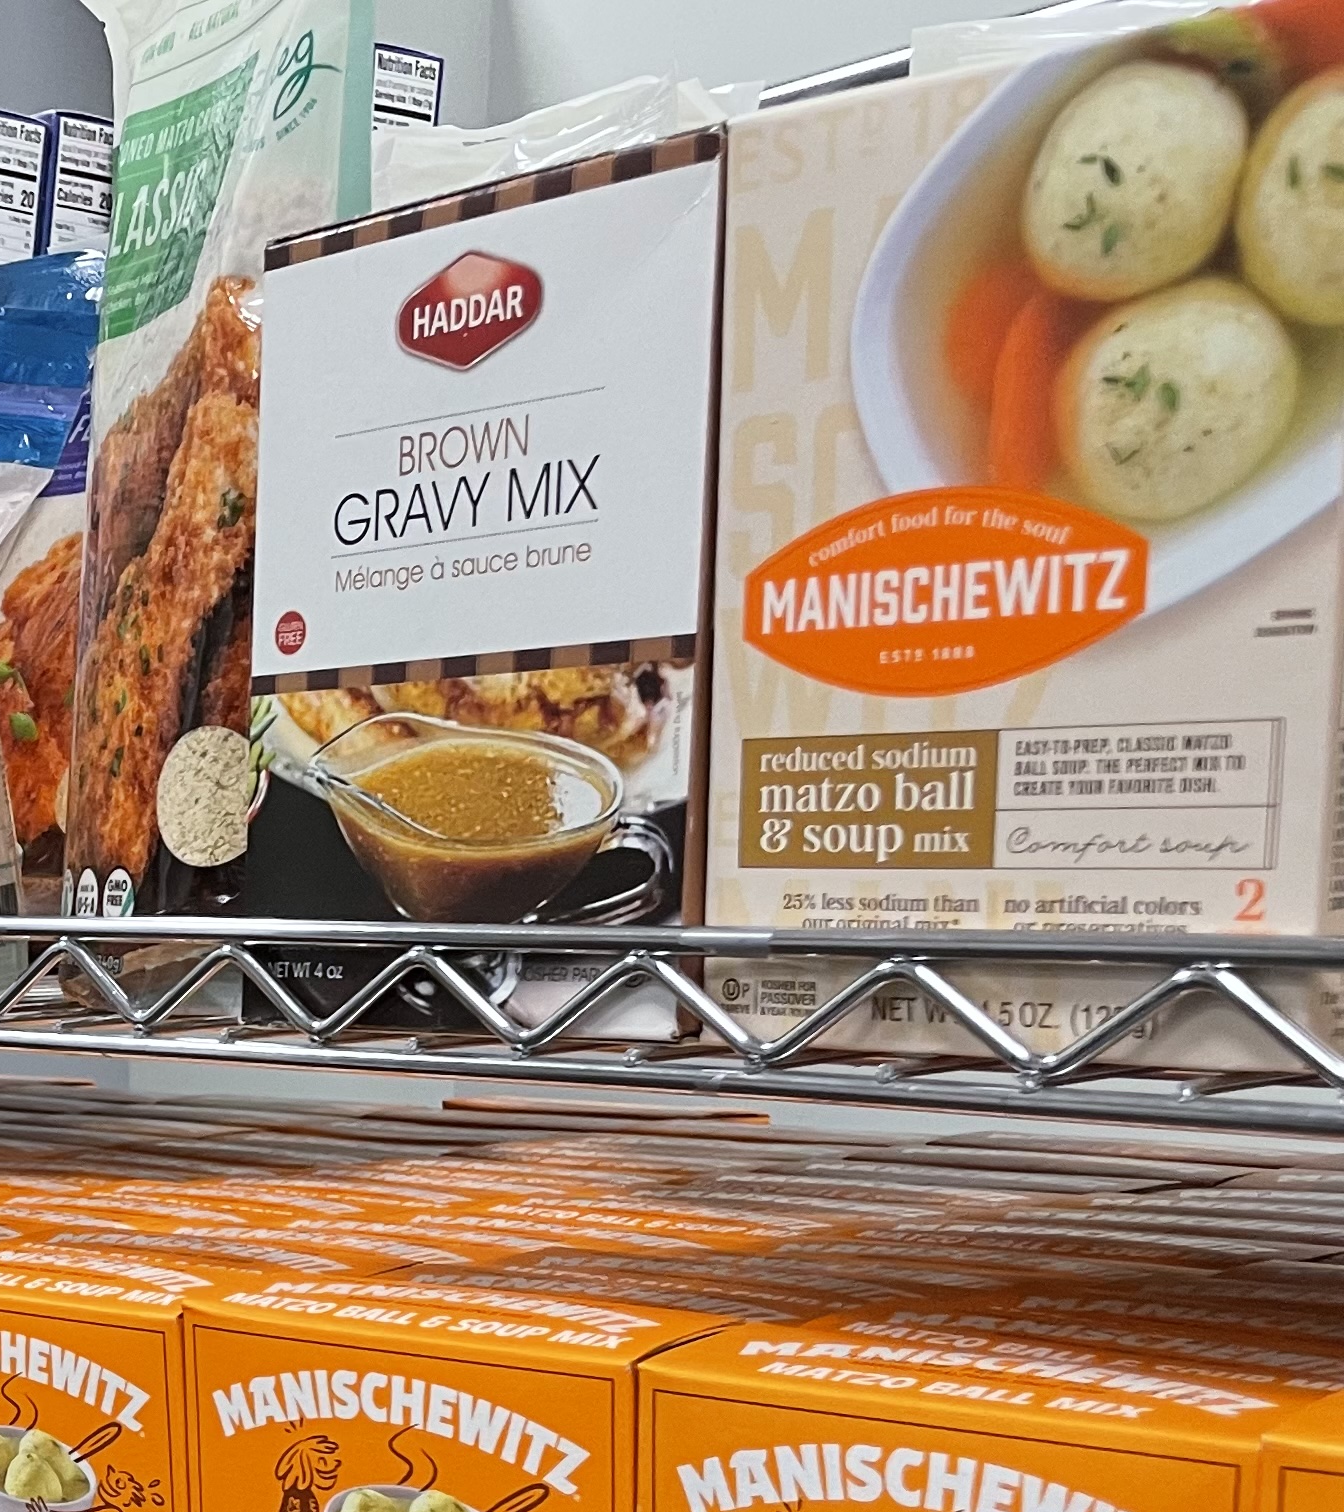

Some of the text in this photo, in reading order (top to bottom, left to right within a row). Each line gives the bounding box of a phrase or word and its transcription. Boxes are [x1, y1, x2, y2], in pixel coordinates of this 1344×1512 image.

[412, 285, 523, 339] HADDAR
[398, 415, 530, 476] BROWN
[333, 454, 599, 546] GRAVY MIX
[808, 506, 1071, 567] comfort food for the soul
[335, 543, 592, 592] Mélange à sauce brune
[762, 550, 1129, 634] MANISCHEWITZ
[760, 742, 976, 772] reduced sodium
[758, 770, 975, 812] matzo ball
[760, 819, 970, 863] & soup mix
[1006, 827, 1252, 862] Comfort soup
[783, 893, 979, 912] 25% less sodium than
[1004, 895, 1202, 915] no artificial colors
[1234, 878, 1266, 921] 2
[293, 961, 343, 980] WT 4 oz
[739, 1340, 1280, 1416] MANISCHEWITZ
[759, 1360, 1153, 1418] MATZO BALL MIX
[212, 1369, 592, 1497] MANISCHEWITZ
